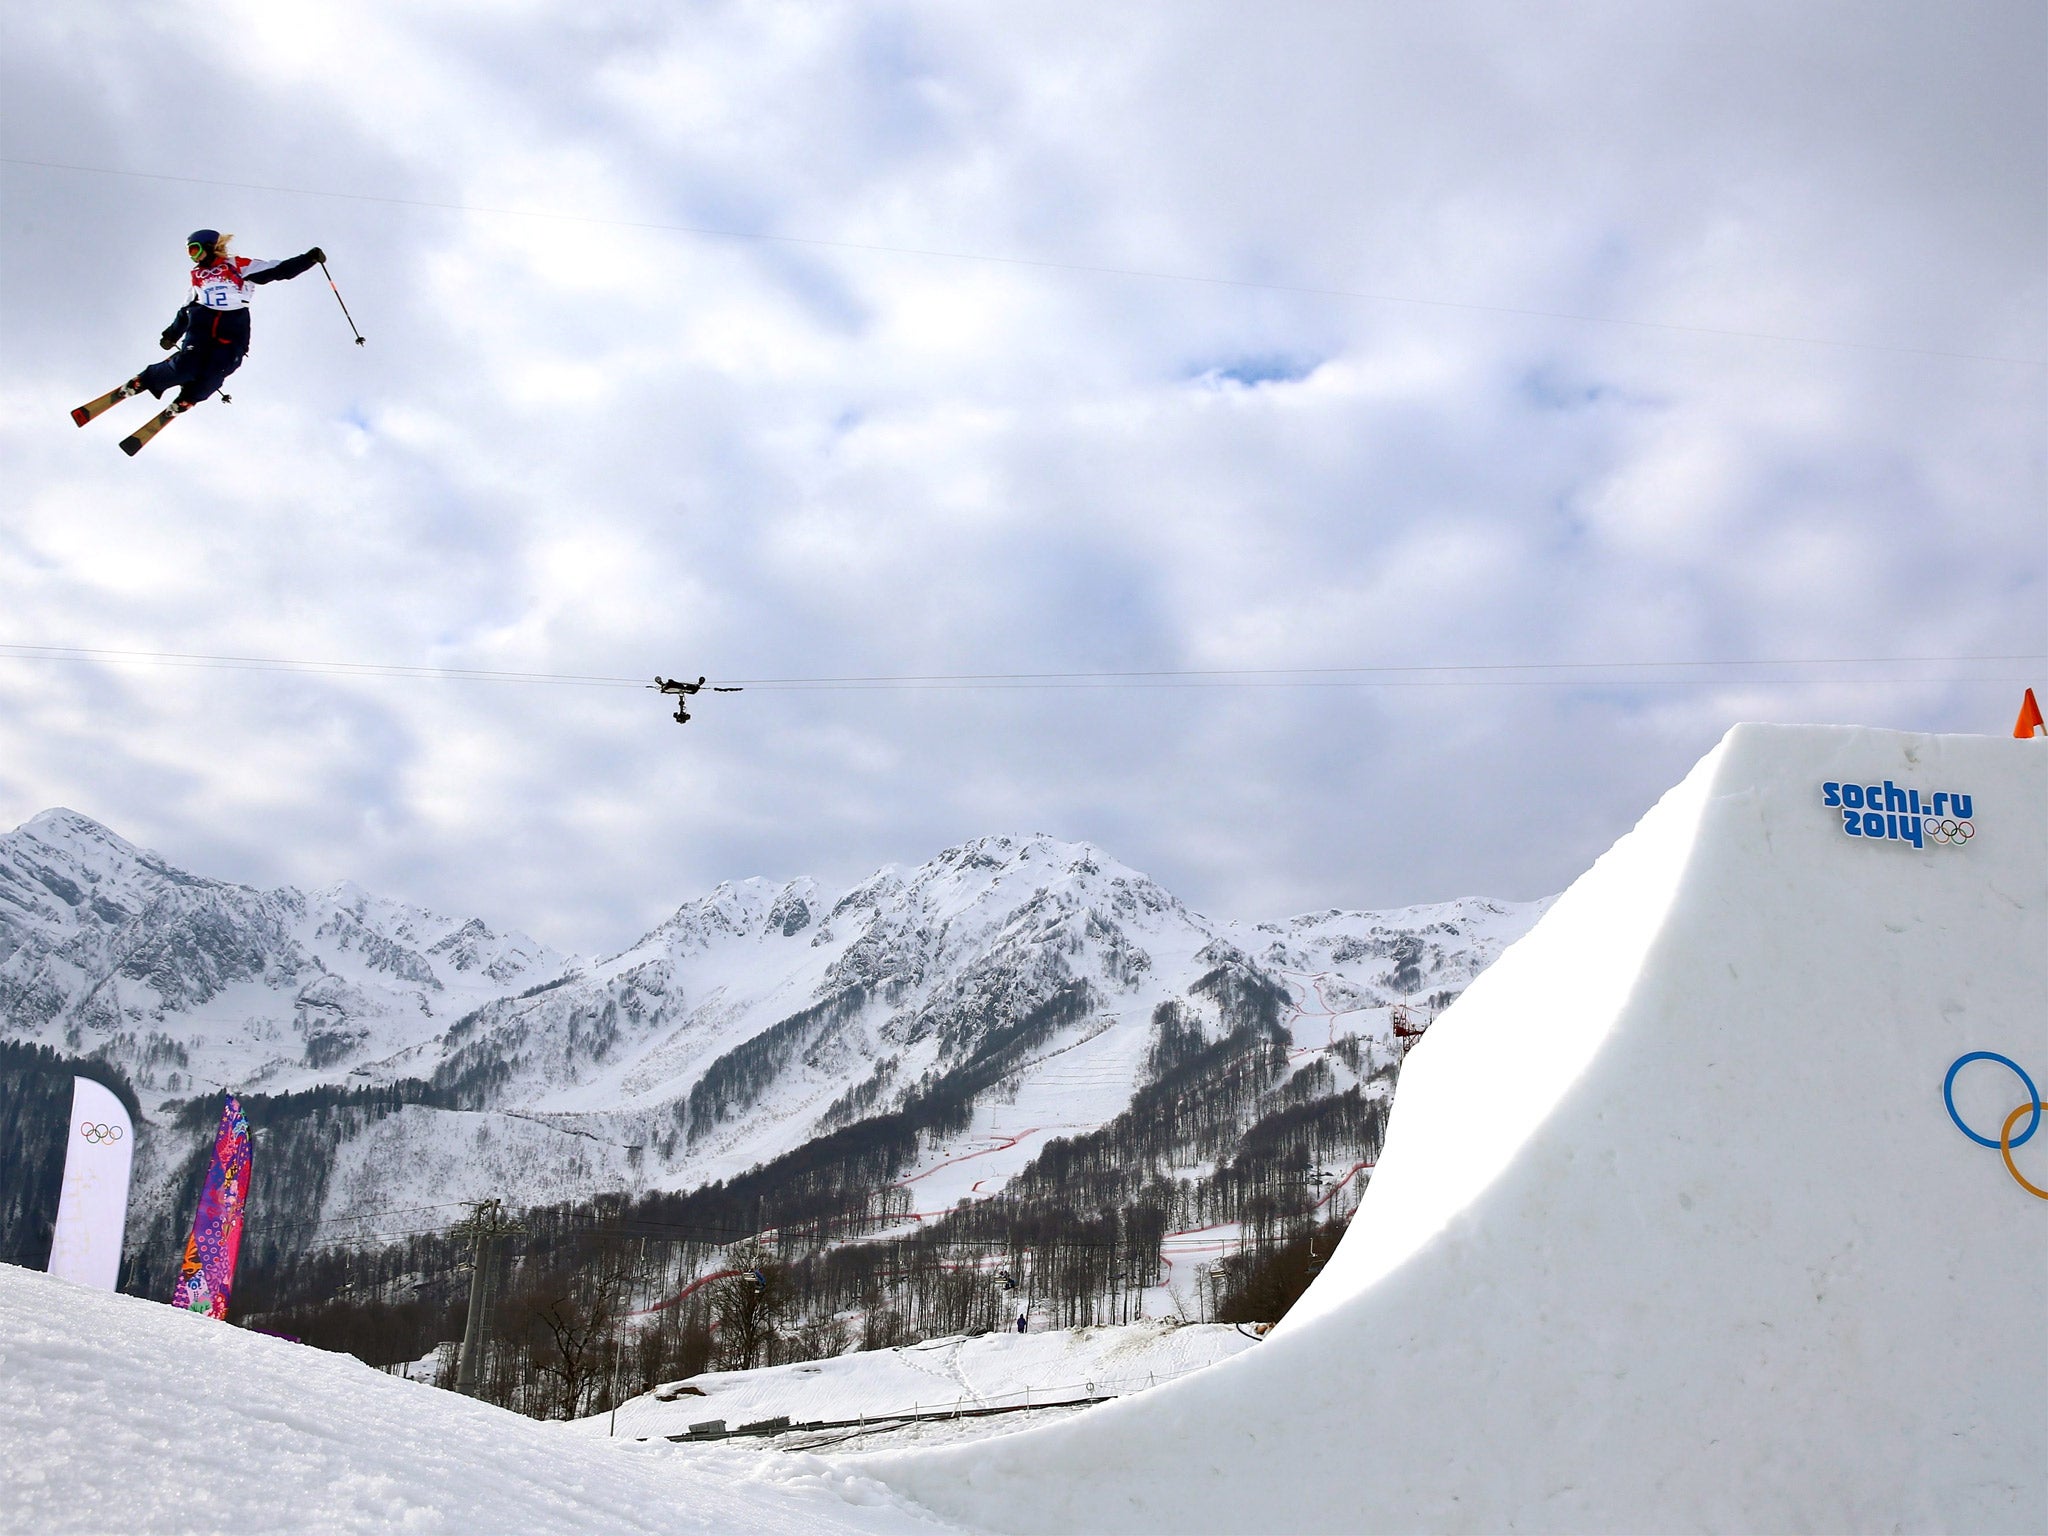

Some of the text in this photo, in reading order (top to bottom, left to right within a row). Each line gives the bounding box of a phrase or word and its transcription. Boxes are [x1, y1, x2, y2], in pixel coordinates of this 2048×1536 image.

[204, 290, 228, 306] 12
[1822, 780, 1973, 818] sochi.ru
[1843, 810, 1924, 849] 2014
